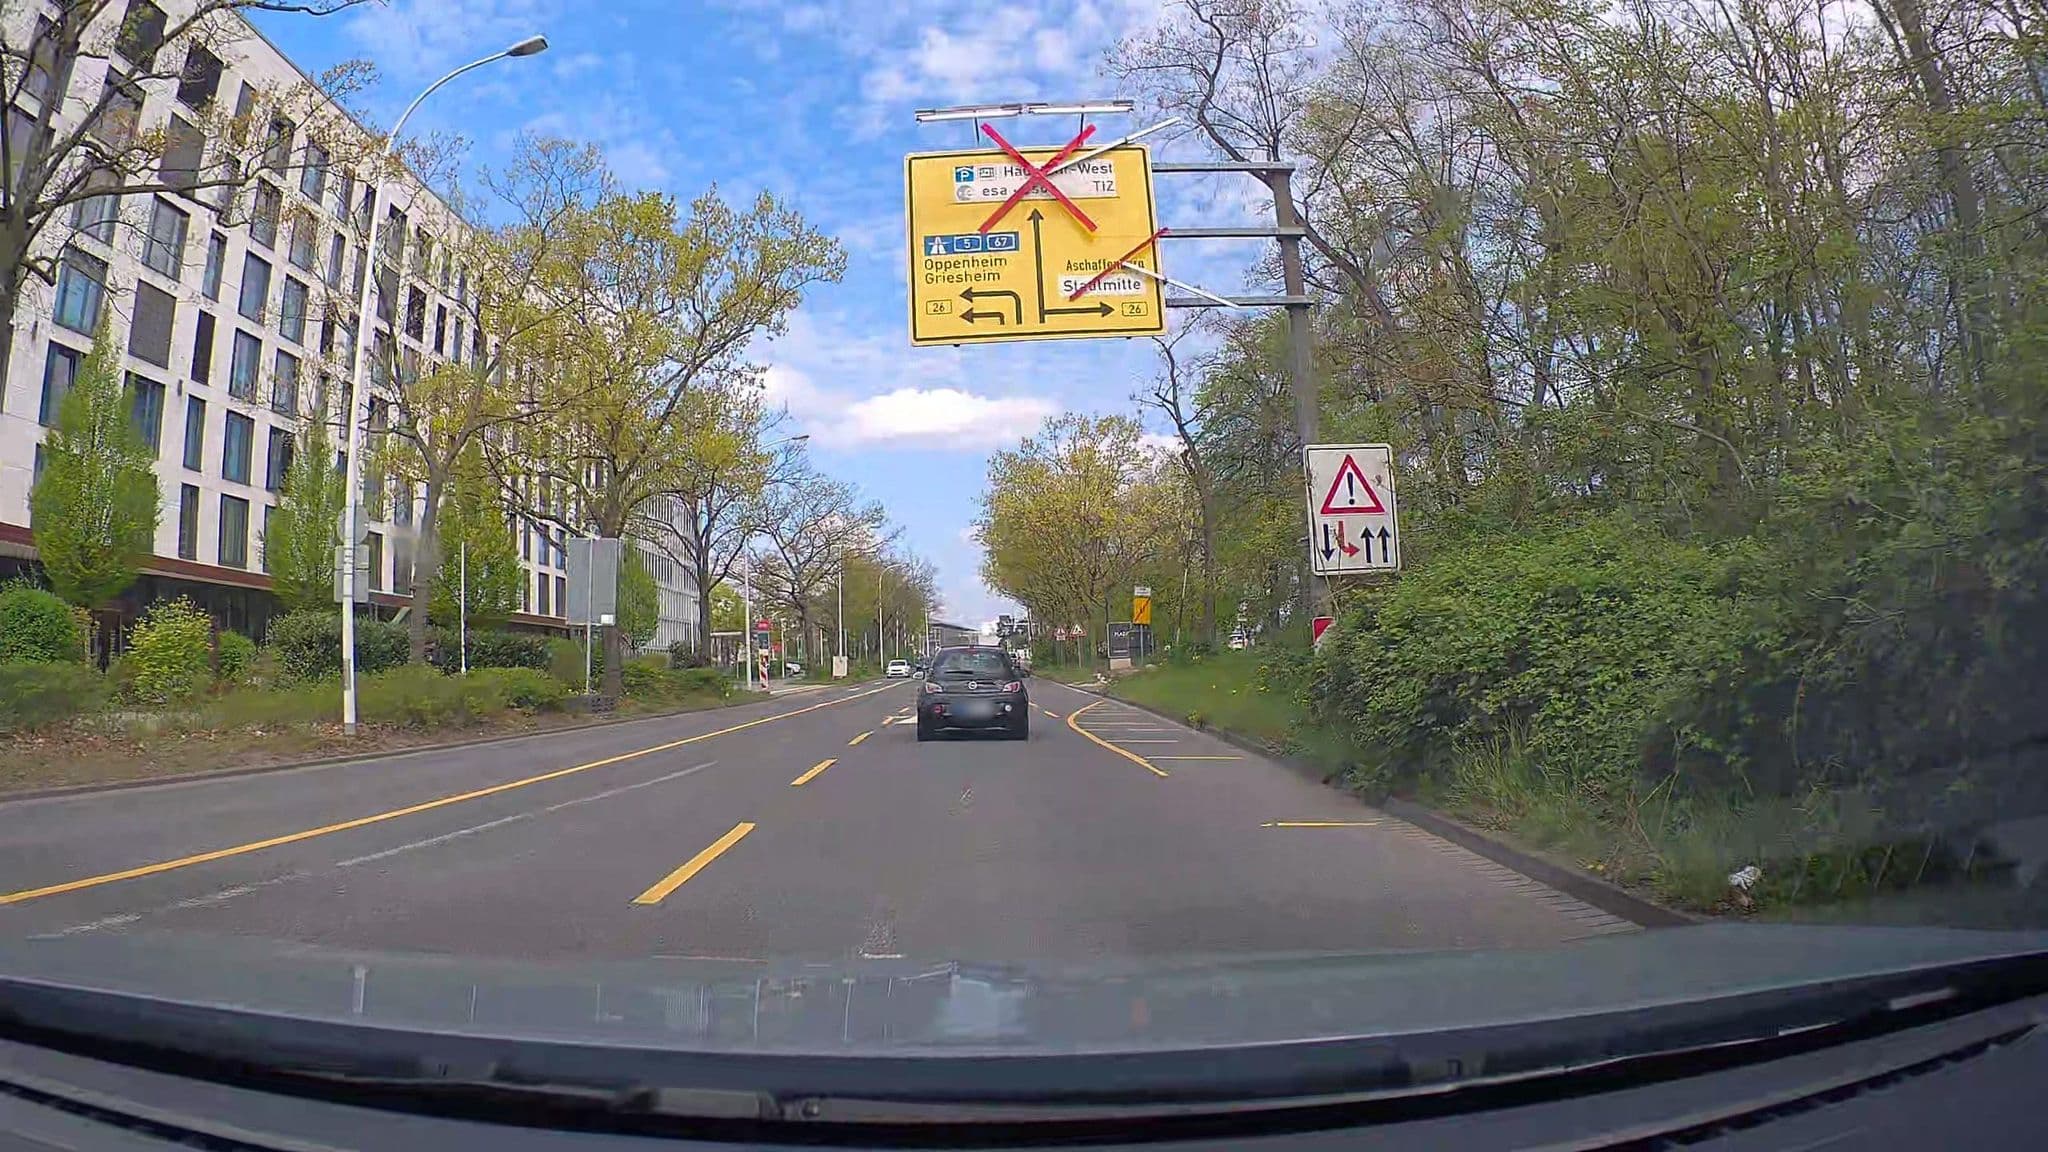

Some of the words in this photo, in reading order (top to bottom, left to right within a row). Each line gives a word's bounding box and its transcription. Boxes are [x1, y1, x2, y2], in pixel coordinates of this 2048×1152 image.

[982, 186, 1007, 196] esa
[1093, 180, 1115, 192] TIZ
[963, 238, 971, 249] 5
[994, 237, 1007, 247] 67
[924, 256, 1008, 273] Oppenheim
[924, 269, 1001, 285] Griesheim
[932, 302, 946, 313] 26
[1128, 304, 1142, 314] 26
